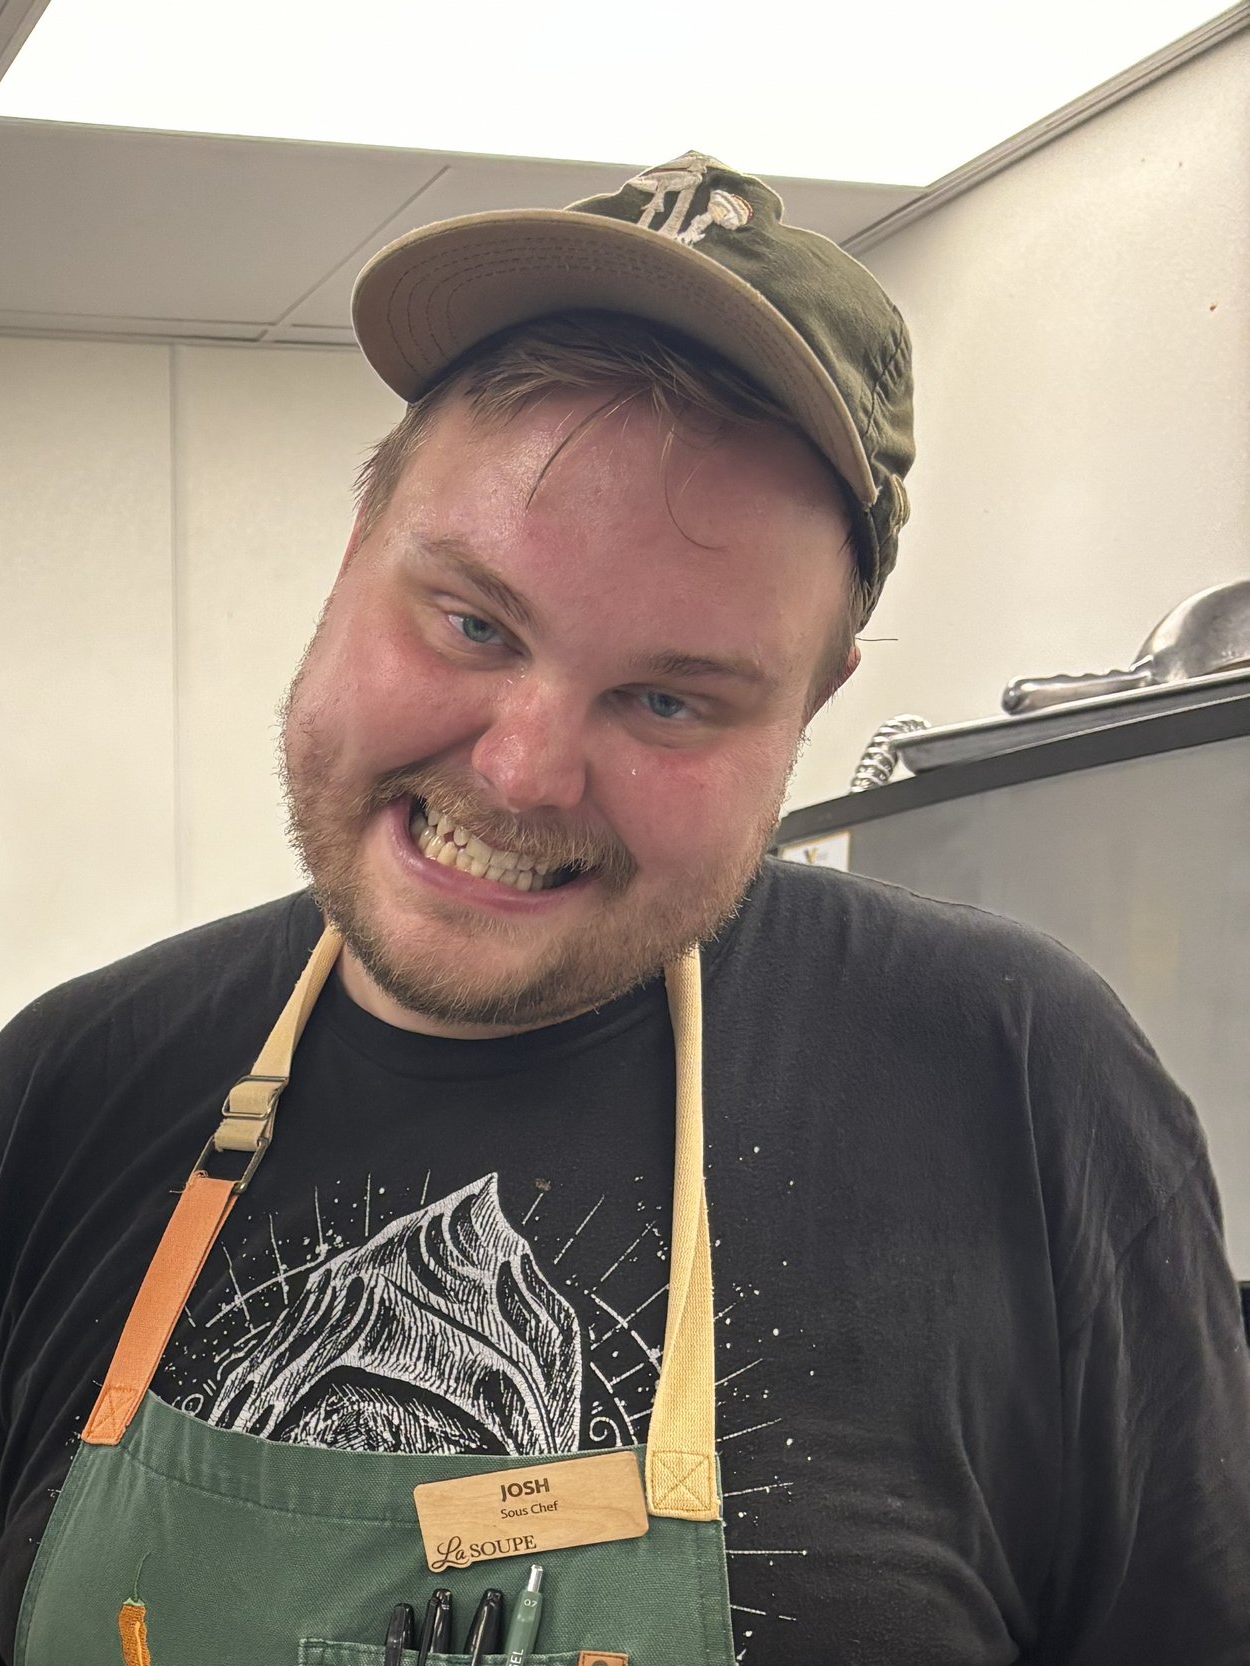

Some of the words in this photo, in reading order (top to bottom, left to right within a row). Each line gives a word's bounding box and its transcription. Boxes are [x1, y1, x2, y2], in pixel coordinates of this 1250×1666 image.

[501, 1478, 550, 1502] JOSH
[501, 1506, 529, 1519] Sous
[530, 1501, 559, 1515] Chef
[431, 1536, 470, 1569] La
[470, 1535, 537, 1558] SOUPE
